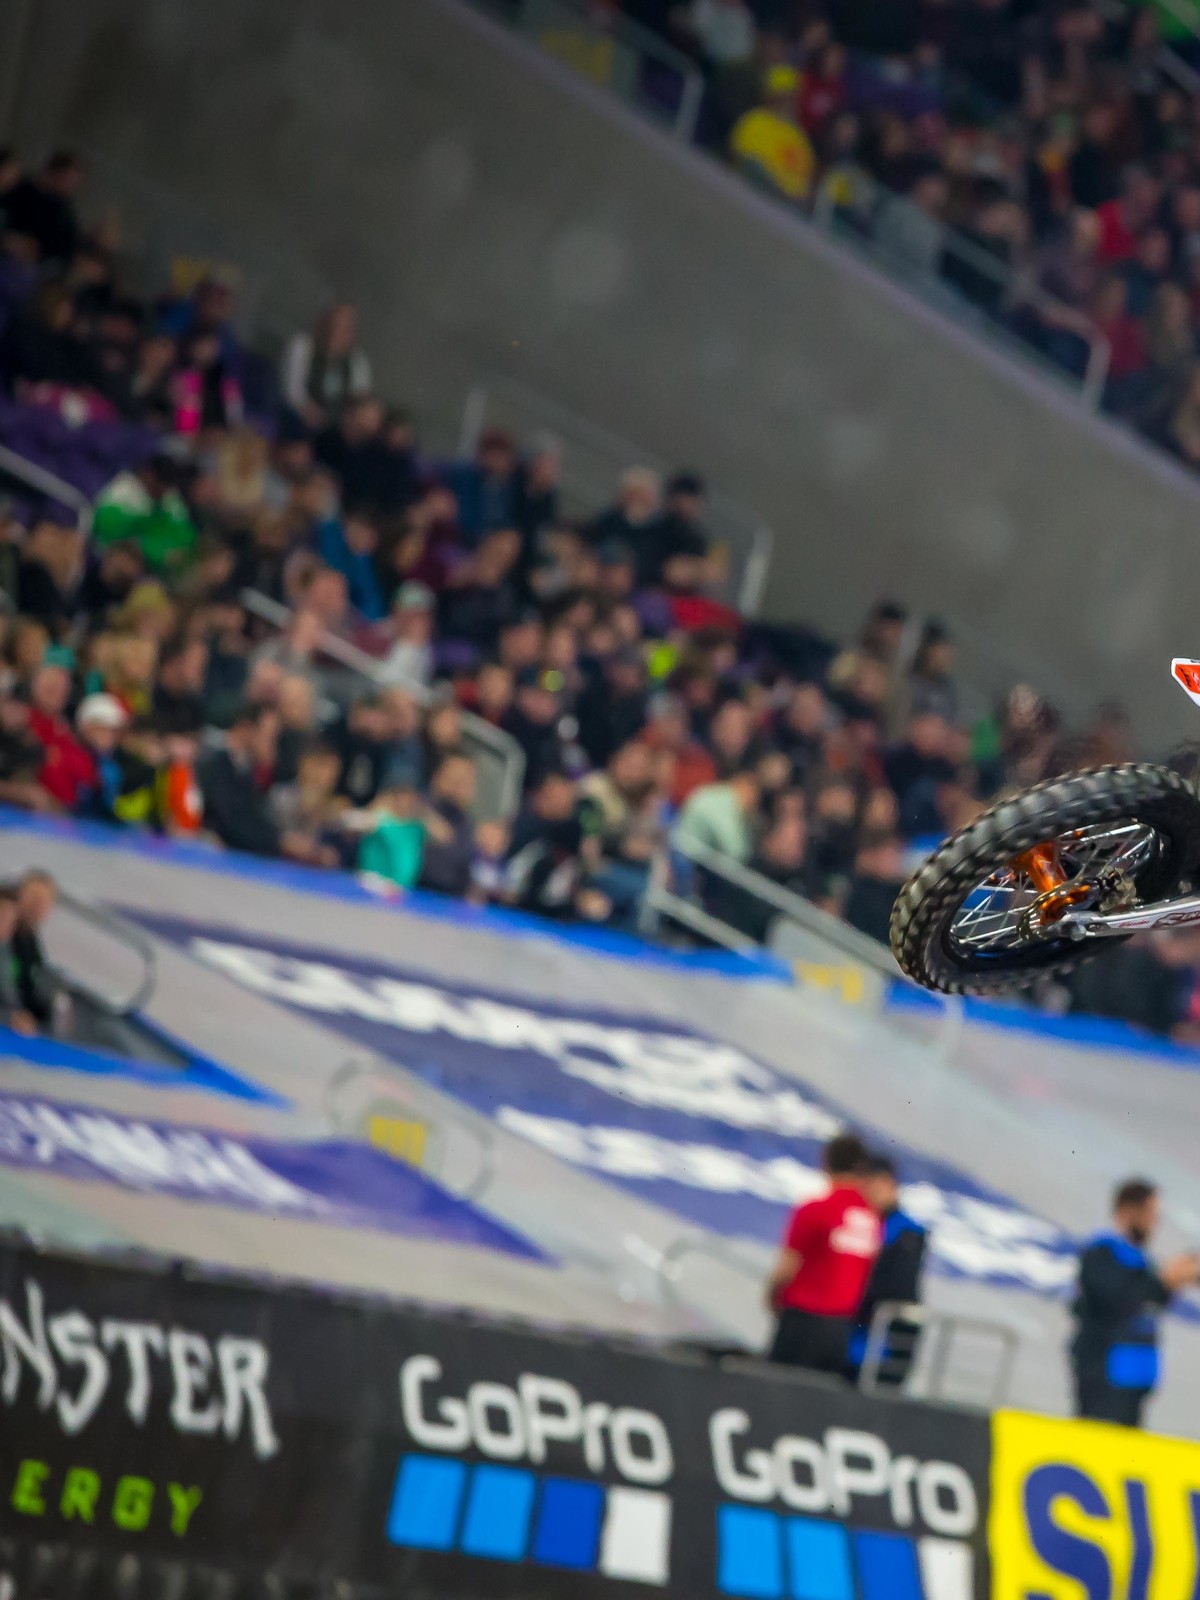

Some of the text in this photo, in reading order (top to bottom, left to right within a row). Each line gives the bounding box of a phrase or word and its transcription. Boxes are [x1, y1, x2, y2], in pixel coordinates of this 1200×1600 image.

[402, 1355, 674, 1485] GoPro
[709, 1408, 978, 1537] GoPro
[13, 1459, 202, 1537] ERGY
